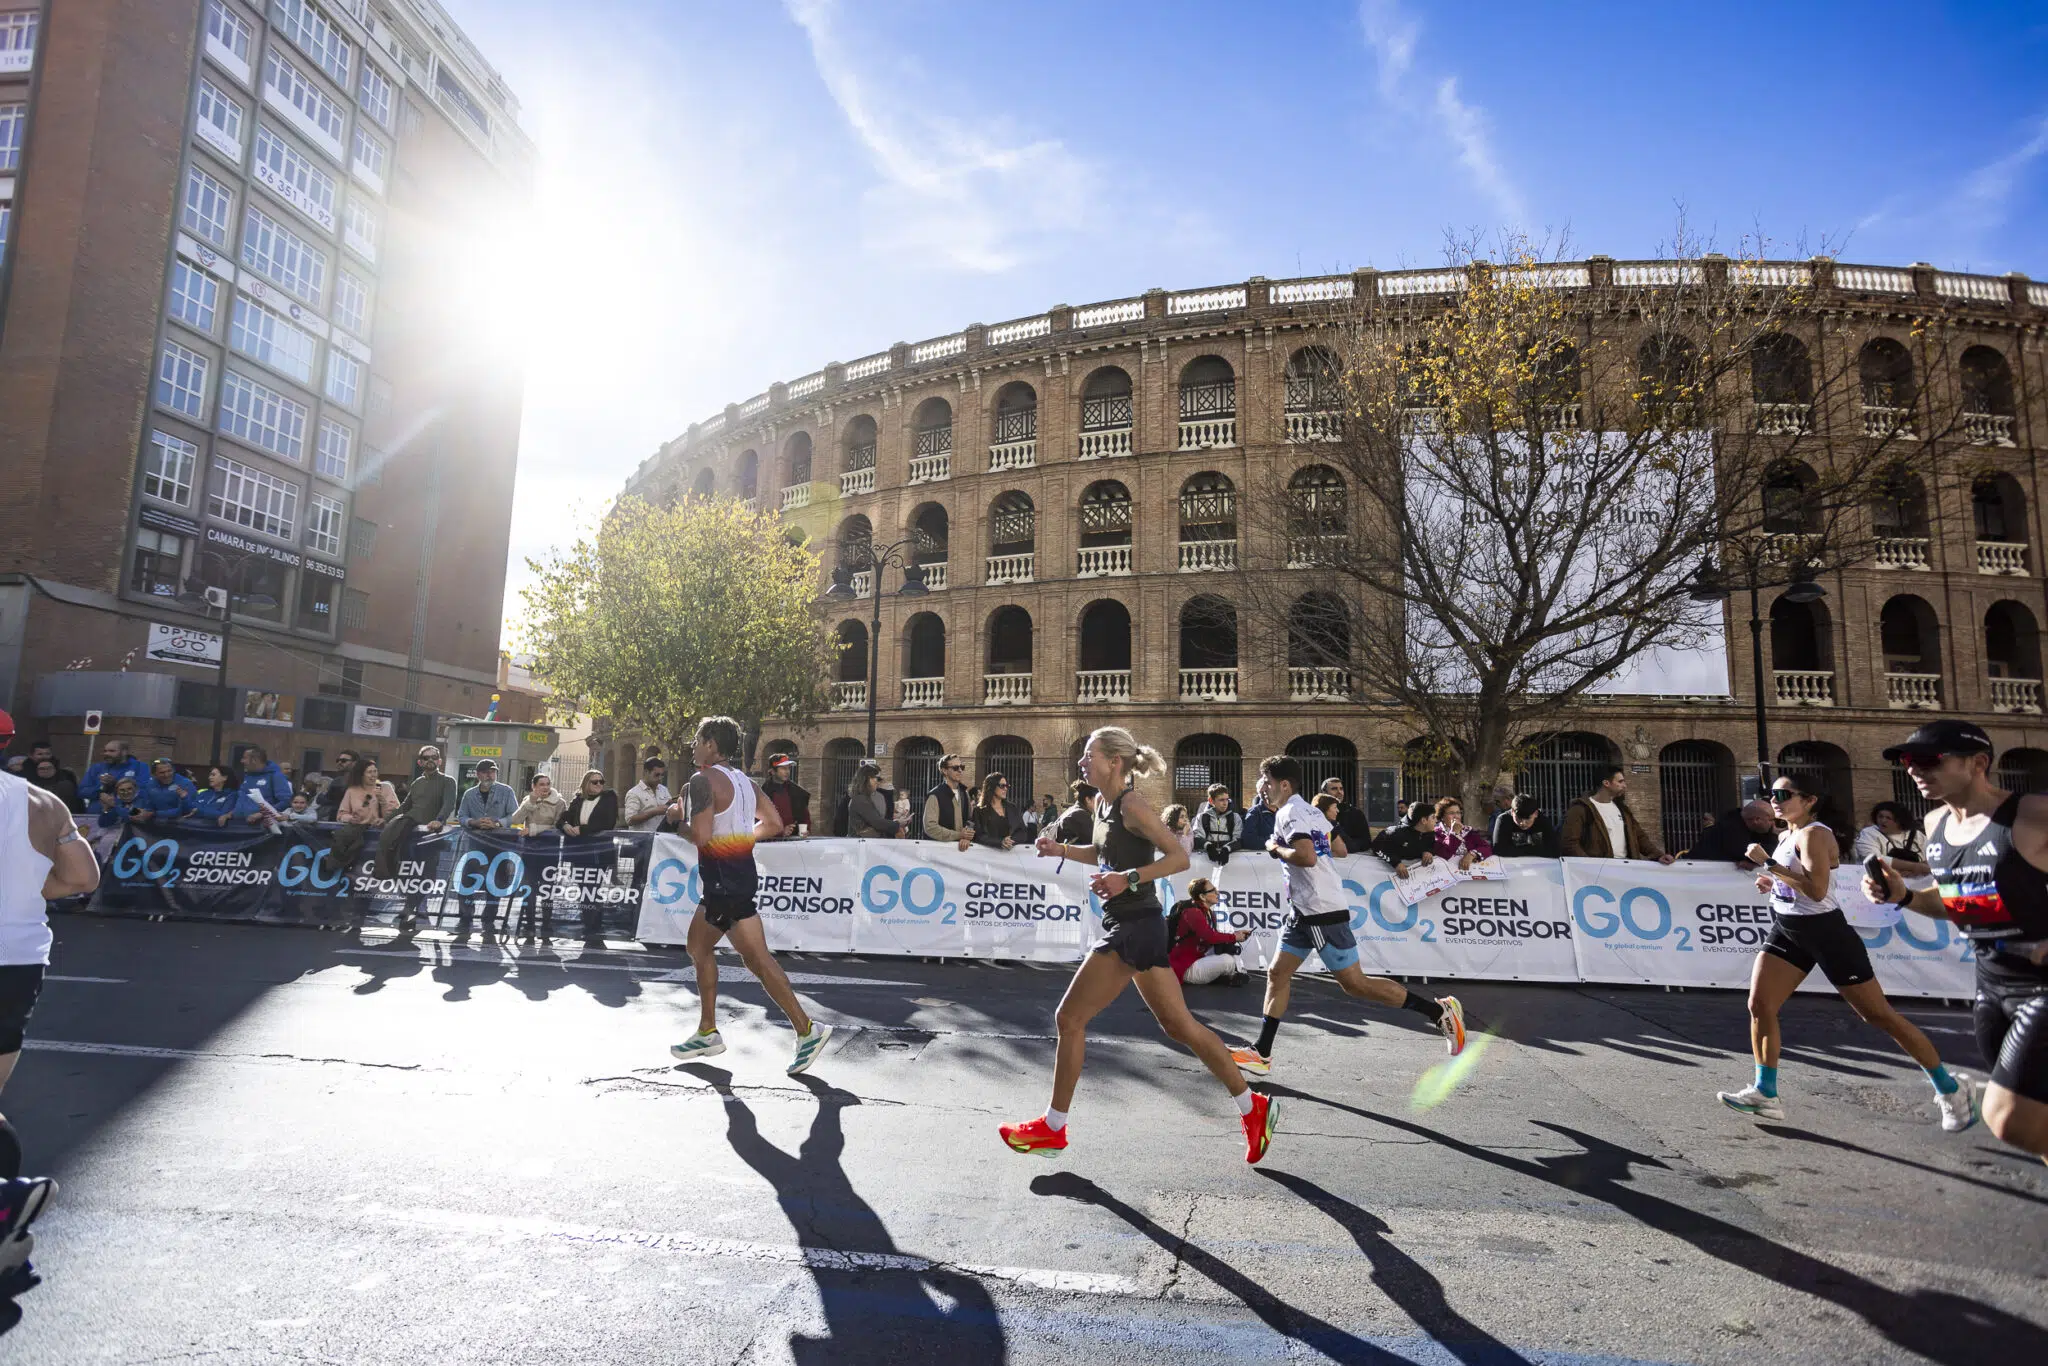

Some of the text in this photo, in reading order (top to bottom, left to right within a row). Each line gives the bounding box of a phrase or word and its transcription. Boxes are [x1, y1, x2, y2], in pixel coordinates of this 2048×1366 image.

[261, 166, 331, 226] 96 351 11 92
[245, 542, 256, 553] DE
[305, 559, 345, 579] 96 352 53 53
[160, 625, 218, 644] OPTICA
[473, 748, 499, 756] ONCE
[113, 836, 181, 888] GO2
[190, 851, 252, 867] GREEN
[361, 859, 425, 876] GEN
[184, 868, 272, 886] SPONSOR
[542, 866, 613, 884] GREEN
[353, 877, 447, 895] SPONSOR
[538, 884, 640, 905] SPONSOR
[861, 864, 957, 925] GO2
[965, 882, 1046, 901] GREEN
[1217, 890, 1281, 909] REEN
[1441, 896, 1528, 917] GREEN
[963, 901, 1082, 922] SPONSOR
[1573, 884, 1694, 952] GO2
[1442, 917, 1571, 940] SPONSOR
[1478, 938, 1523, 946] DEPORTIVOS
[1703, 945, 1737, 953] EVENTOS
